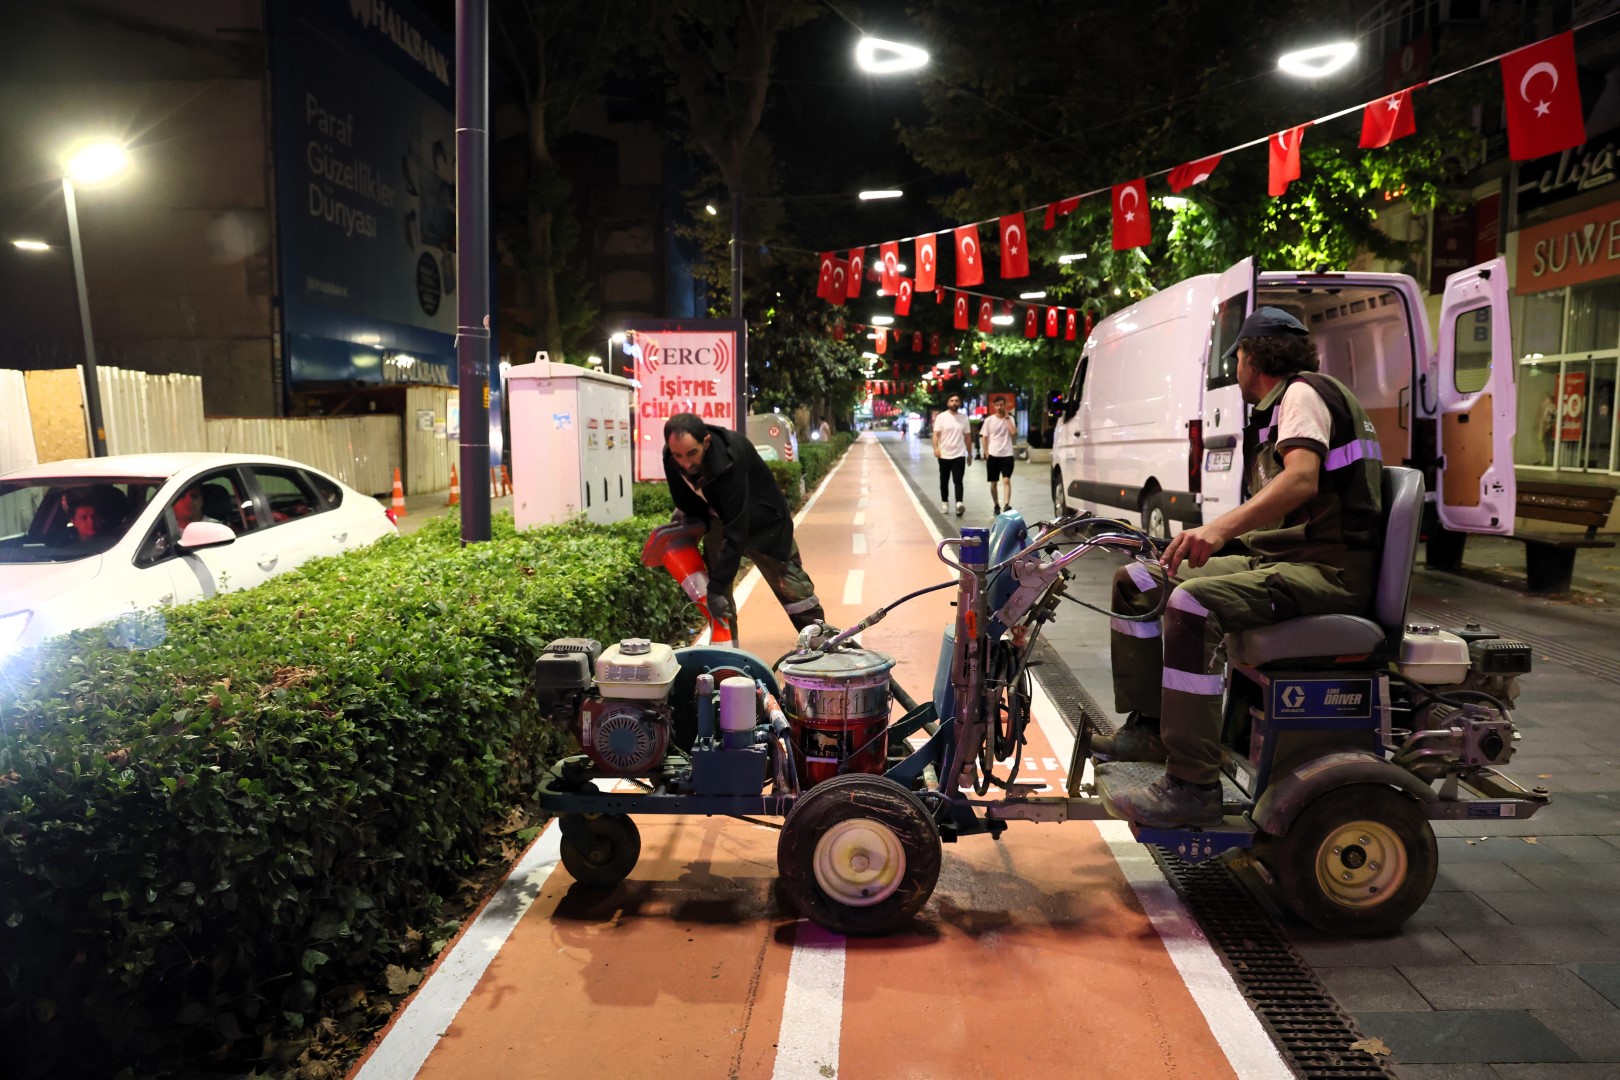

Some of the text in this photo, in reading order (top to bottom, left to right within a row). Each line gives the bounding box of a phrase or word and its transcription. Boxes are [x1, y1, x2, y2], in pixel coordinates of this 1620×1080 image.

[306, 92, 354, 147] Paraf
[307, 140, 396, 208] Güzellikler
[309, 182, 378, 239] Dünyası
[662, 348, 711, 365] ERC
[660, 376, 717, 400] İŞİTME
[1324, 694, 1363, 705] DRIVER
